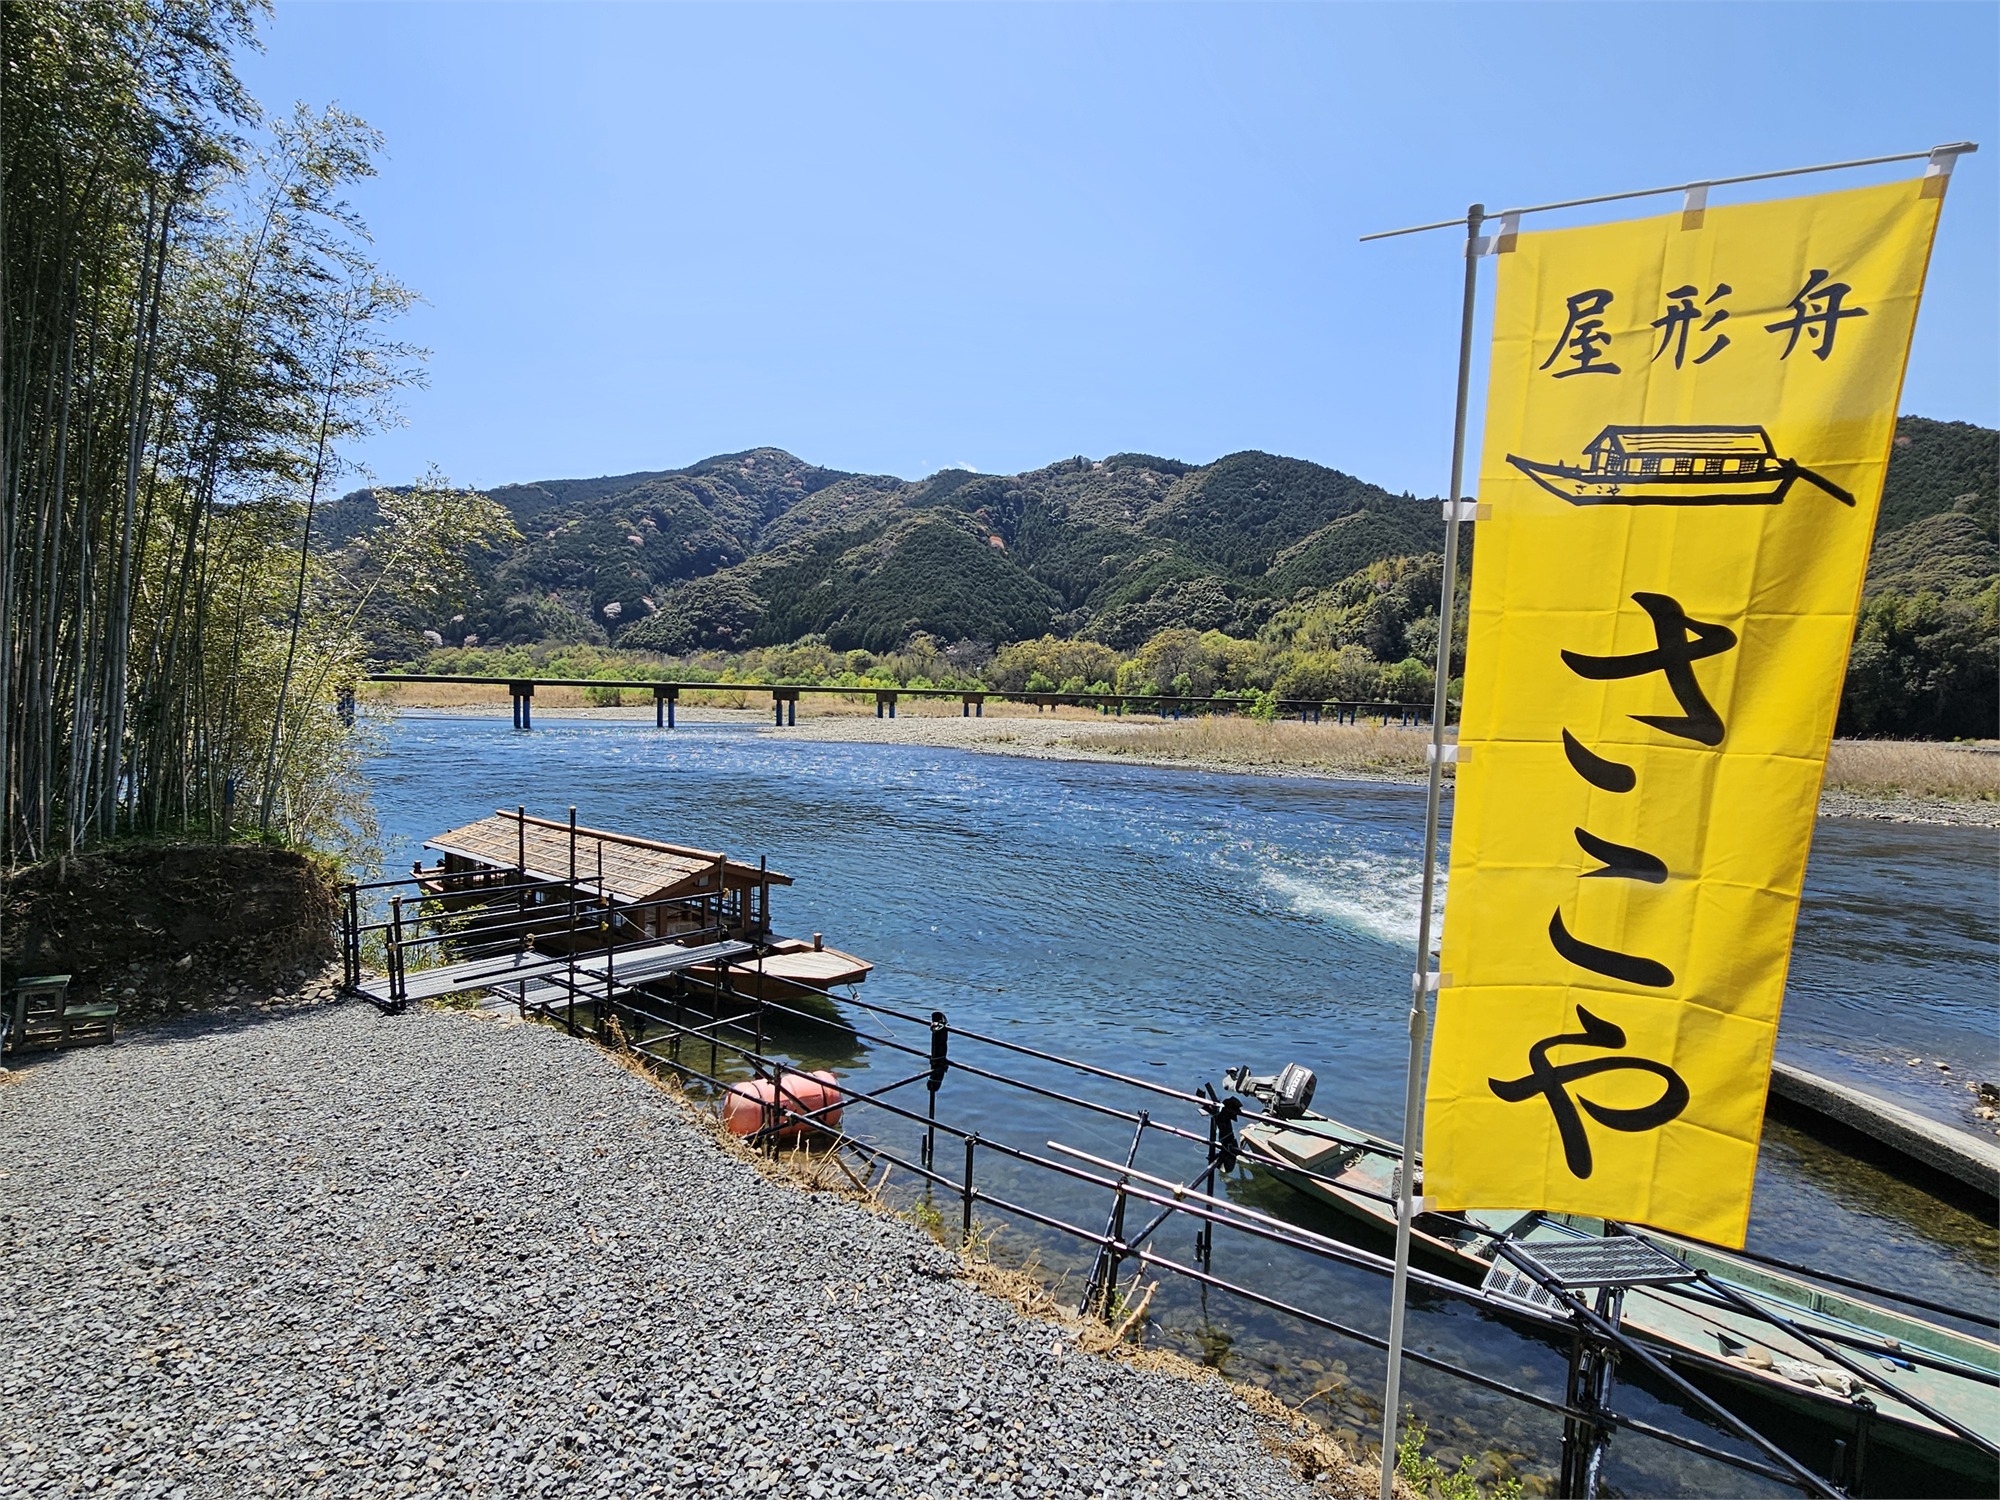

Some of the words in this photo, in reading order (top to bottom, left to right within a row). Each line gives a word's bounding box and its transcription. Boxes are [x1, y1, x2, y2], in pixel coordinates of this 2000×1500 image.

[1539, 269, 1869, 379] 屋形舟
[1575, 484, 1621, 496] さこや
[1488, 591, 1738, 1180] さこや
[1287, 1070, 1305, 1099] SUZUKI
